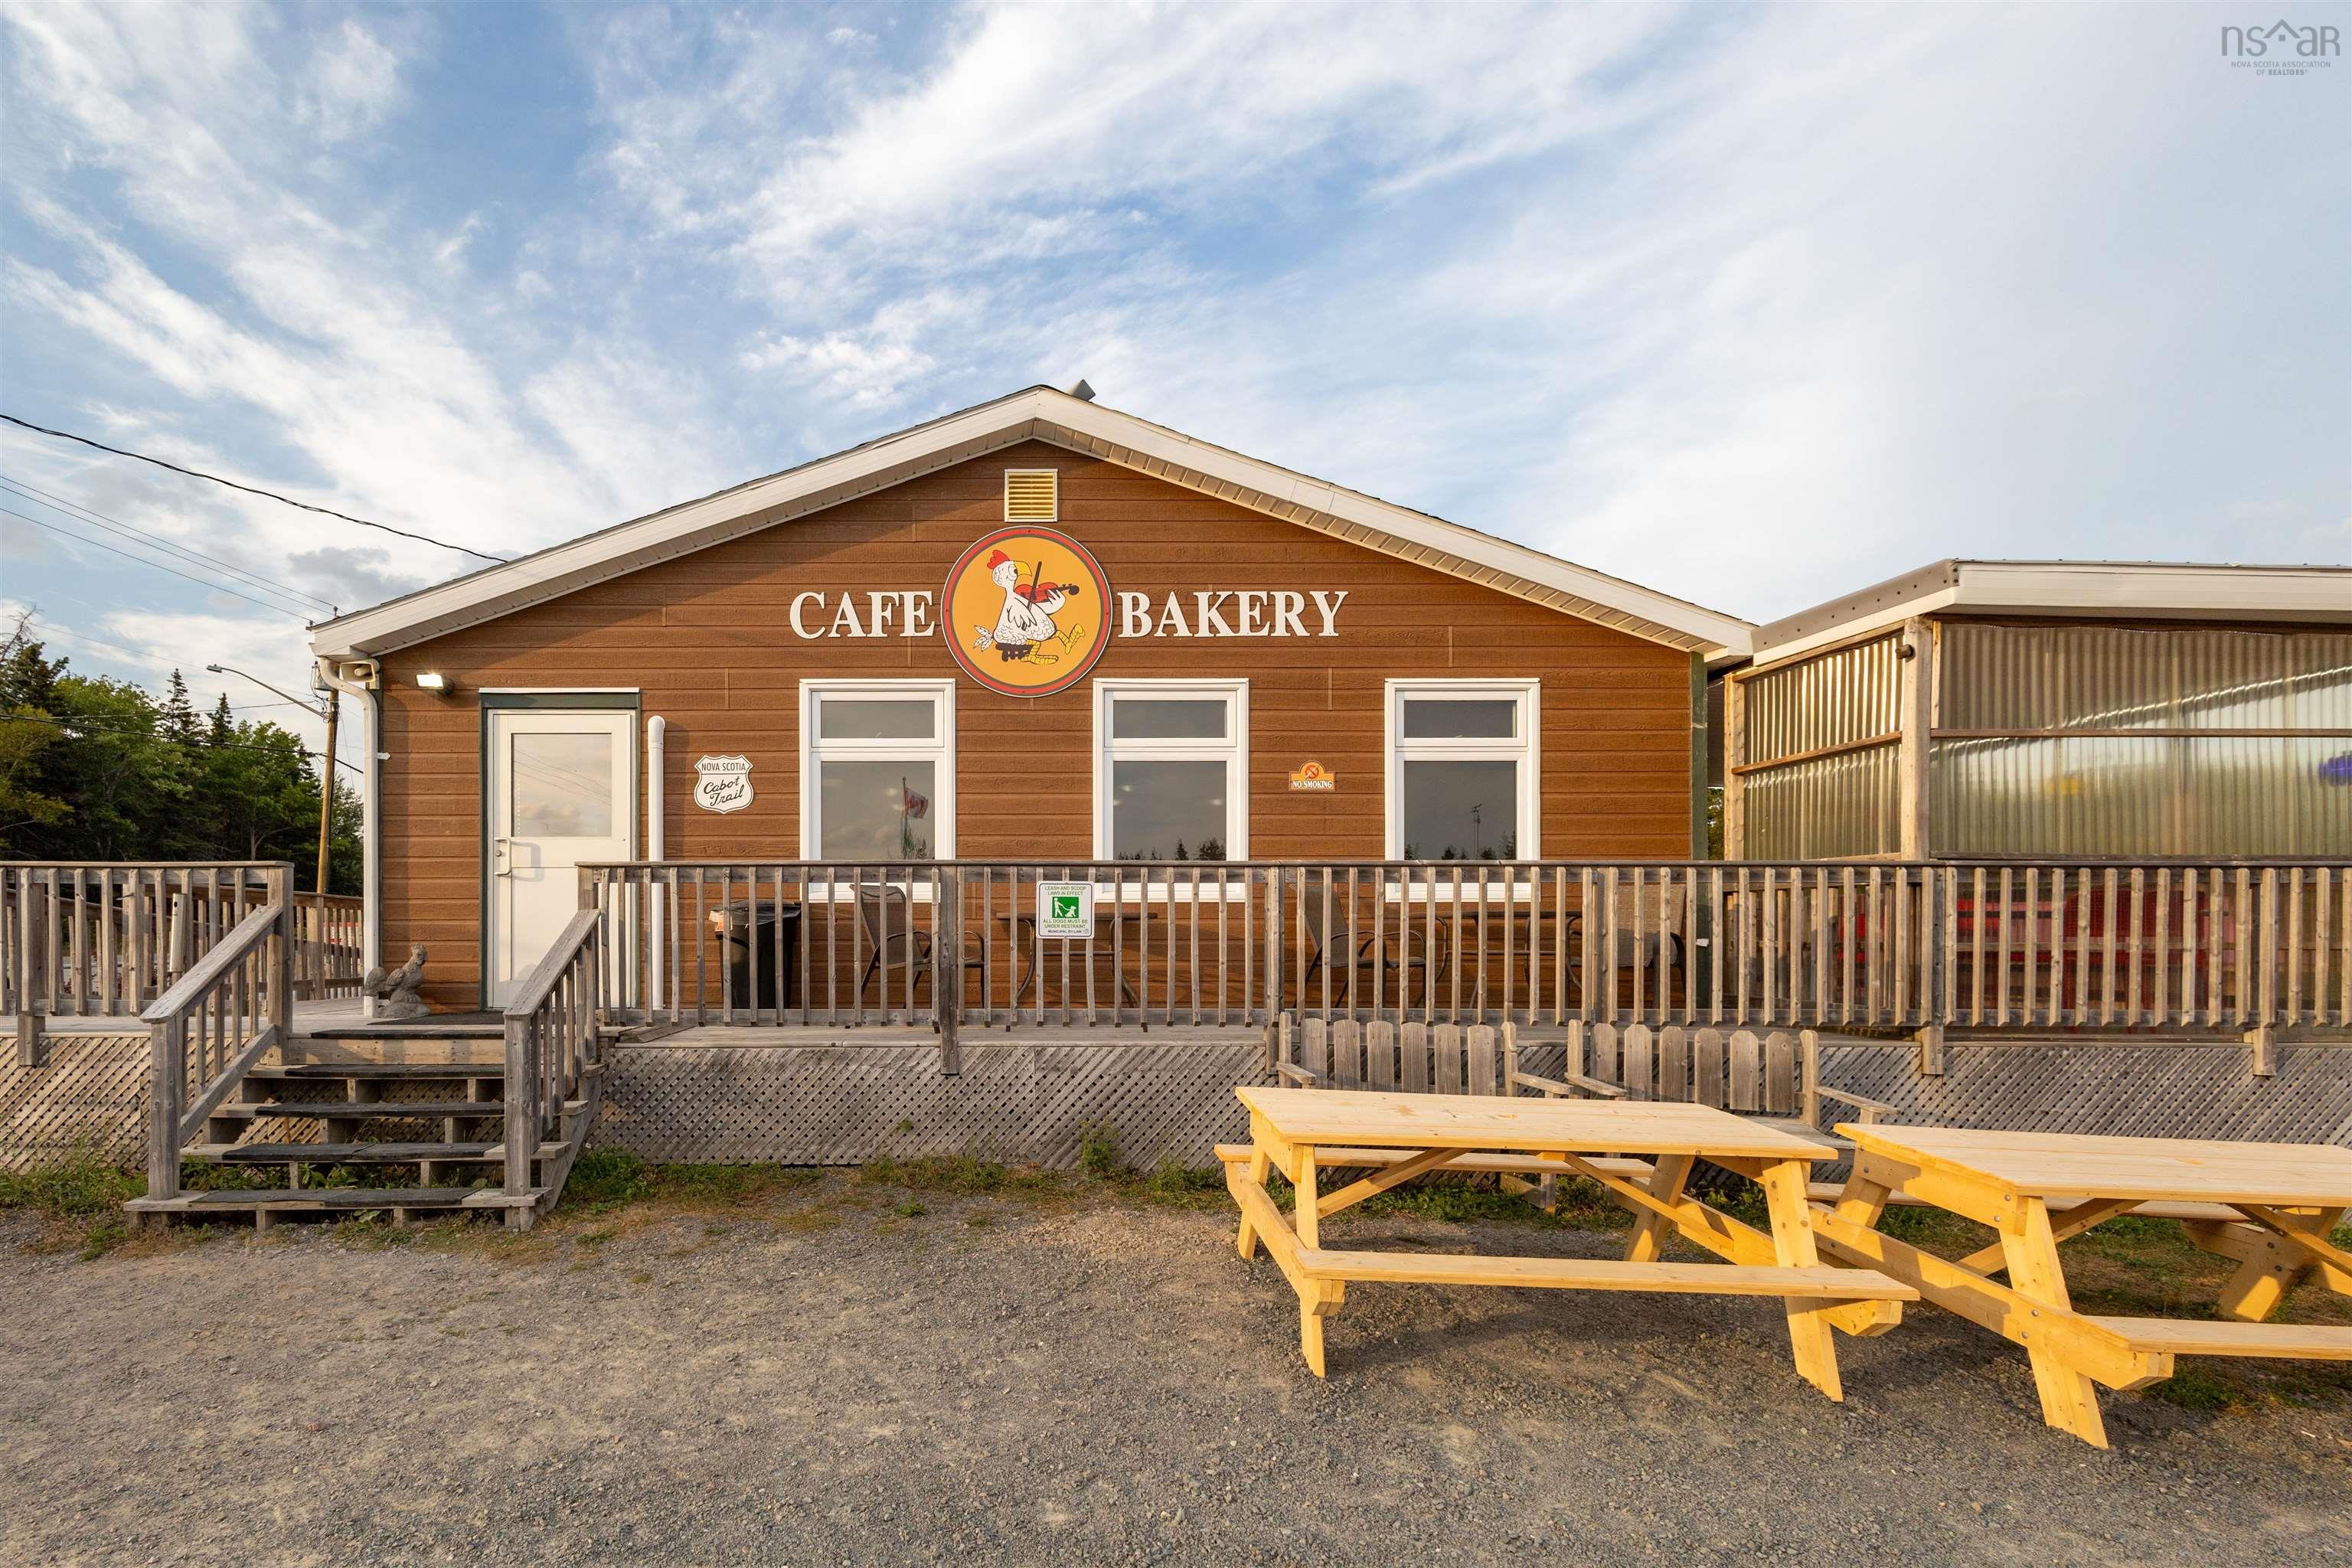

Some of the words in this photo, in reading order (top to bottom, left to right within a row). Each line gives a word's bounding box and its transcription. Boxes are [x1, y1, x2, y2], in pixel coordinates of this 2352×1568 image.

[789, 591, 936, 639] CAFE
[1117, 591, 1349, 638] BAKERY
[701, 763, 720, 771] NOVA
[722, 763, 746, 771] SCOTIA
[703, 776, 740, 795] Cabot
[1292, 780, 1302, 789] NO
[1303, 780, 1332, 789] SMOKING
[710, 784, 745, 807] Trail
